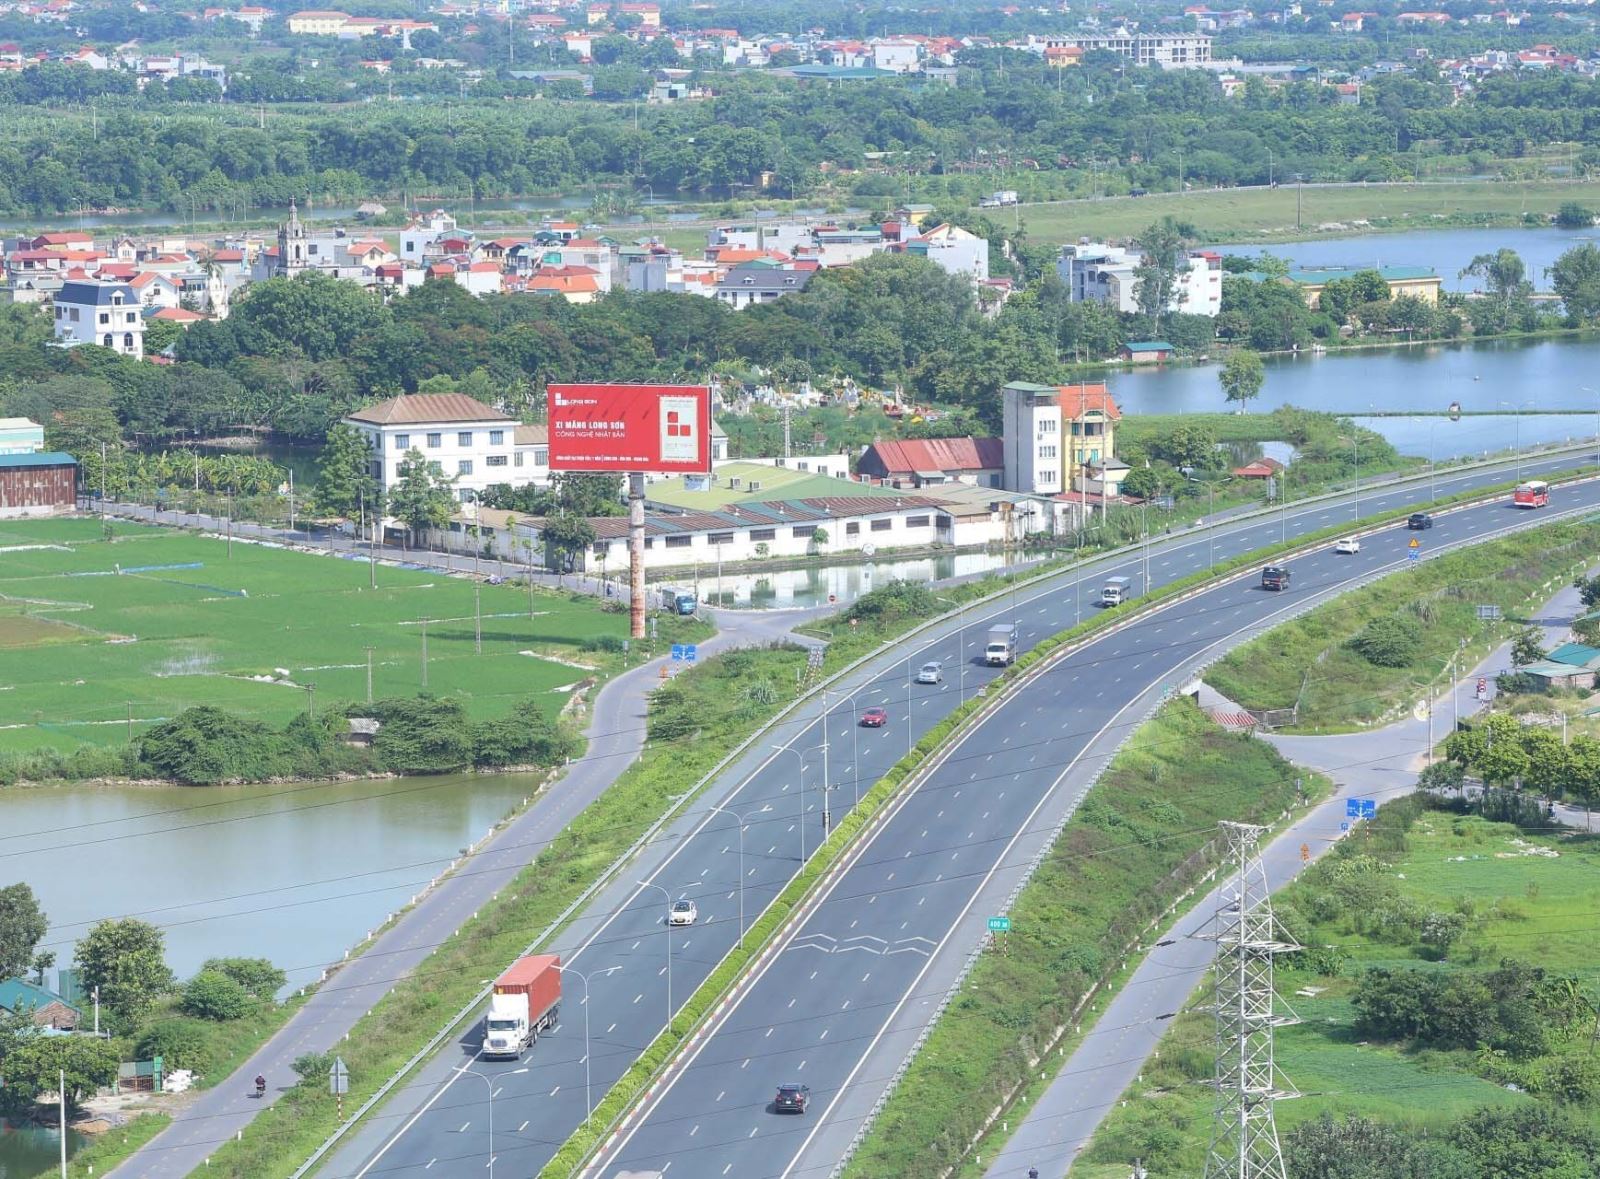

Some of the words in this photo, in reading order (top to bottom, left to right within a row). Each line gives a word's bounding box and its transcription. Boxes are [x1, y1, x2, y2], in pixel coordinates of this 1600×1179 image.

[555, 421, 562, 429] XI
[589, 421, 608, 429] LONG
[989, 920, 1001, 928] 400
